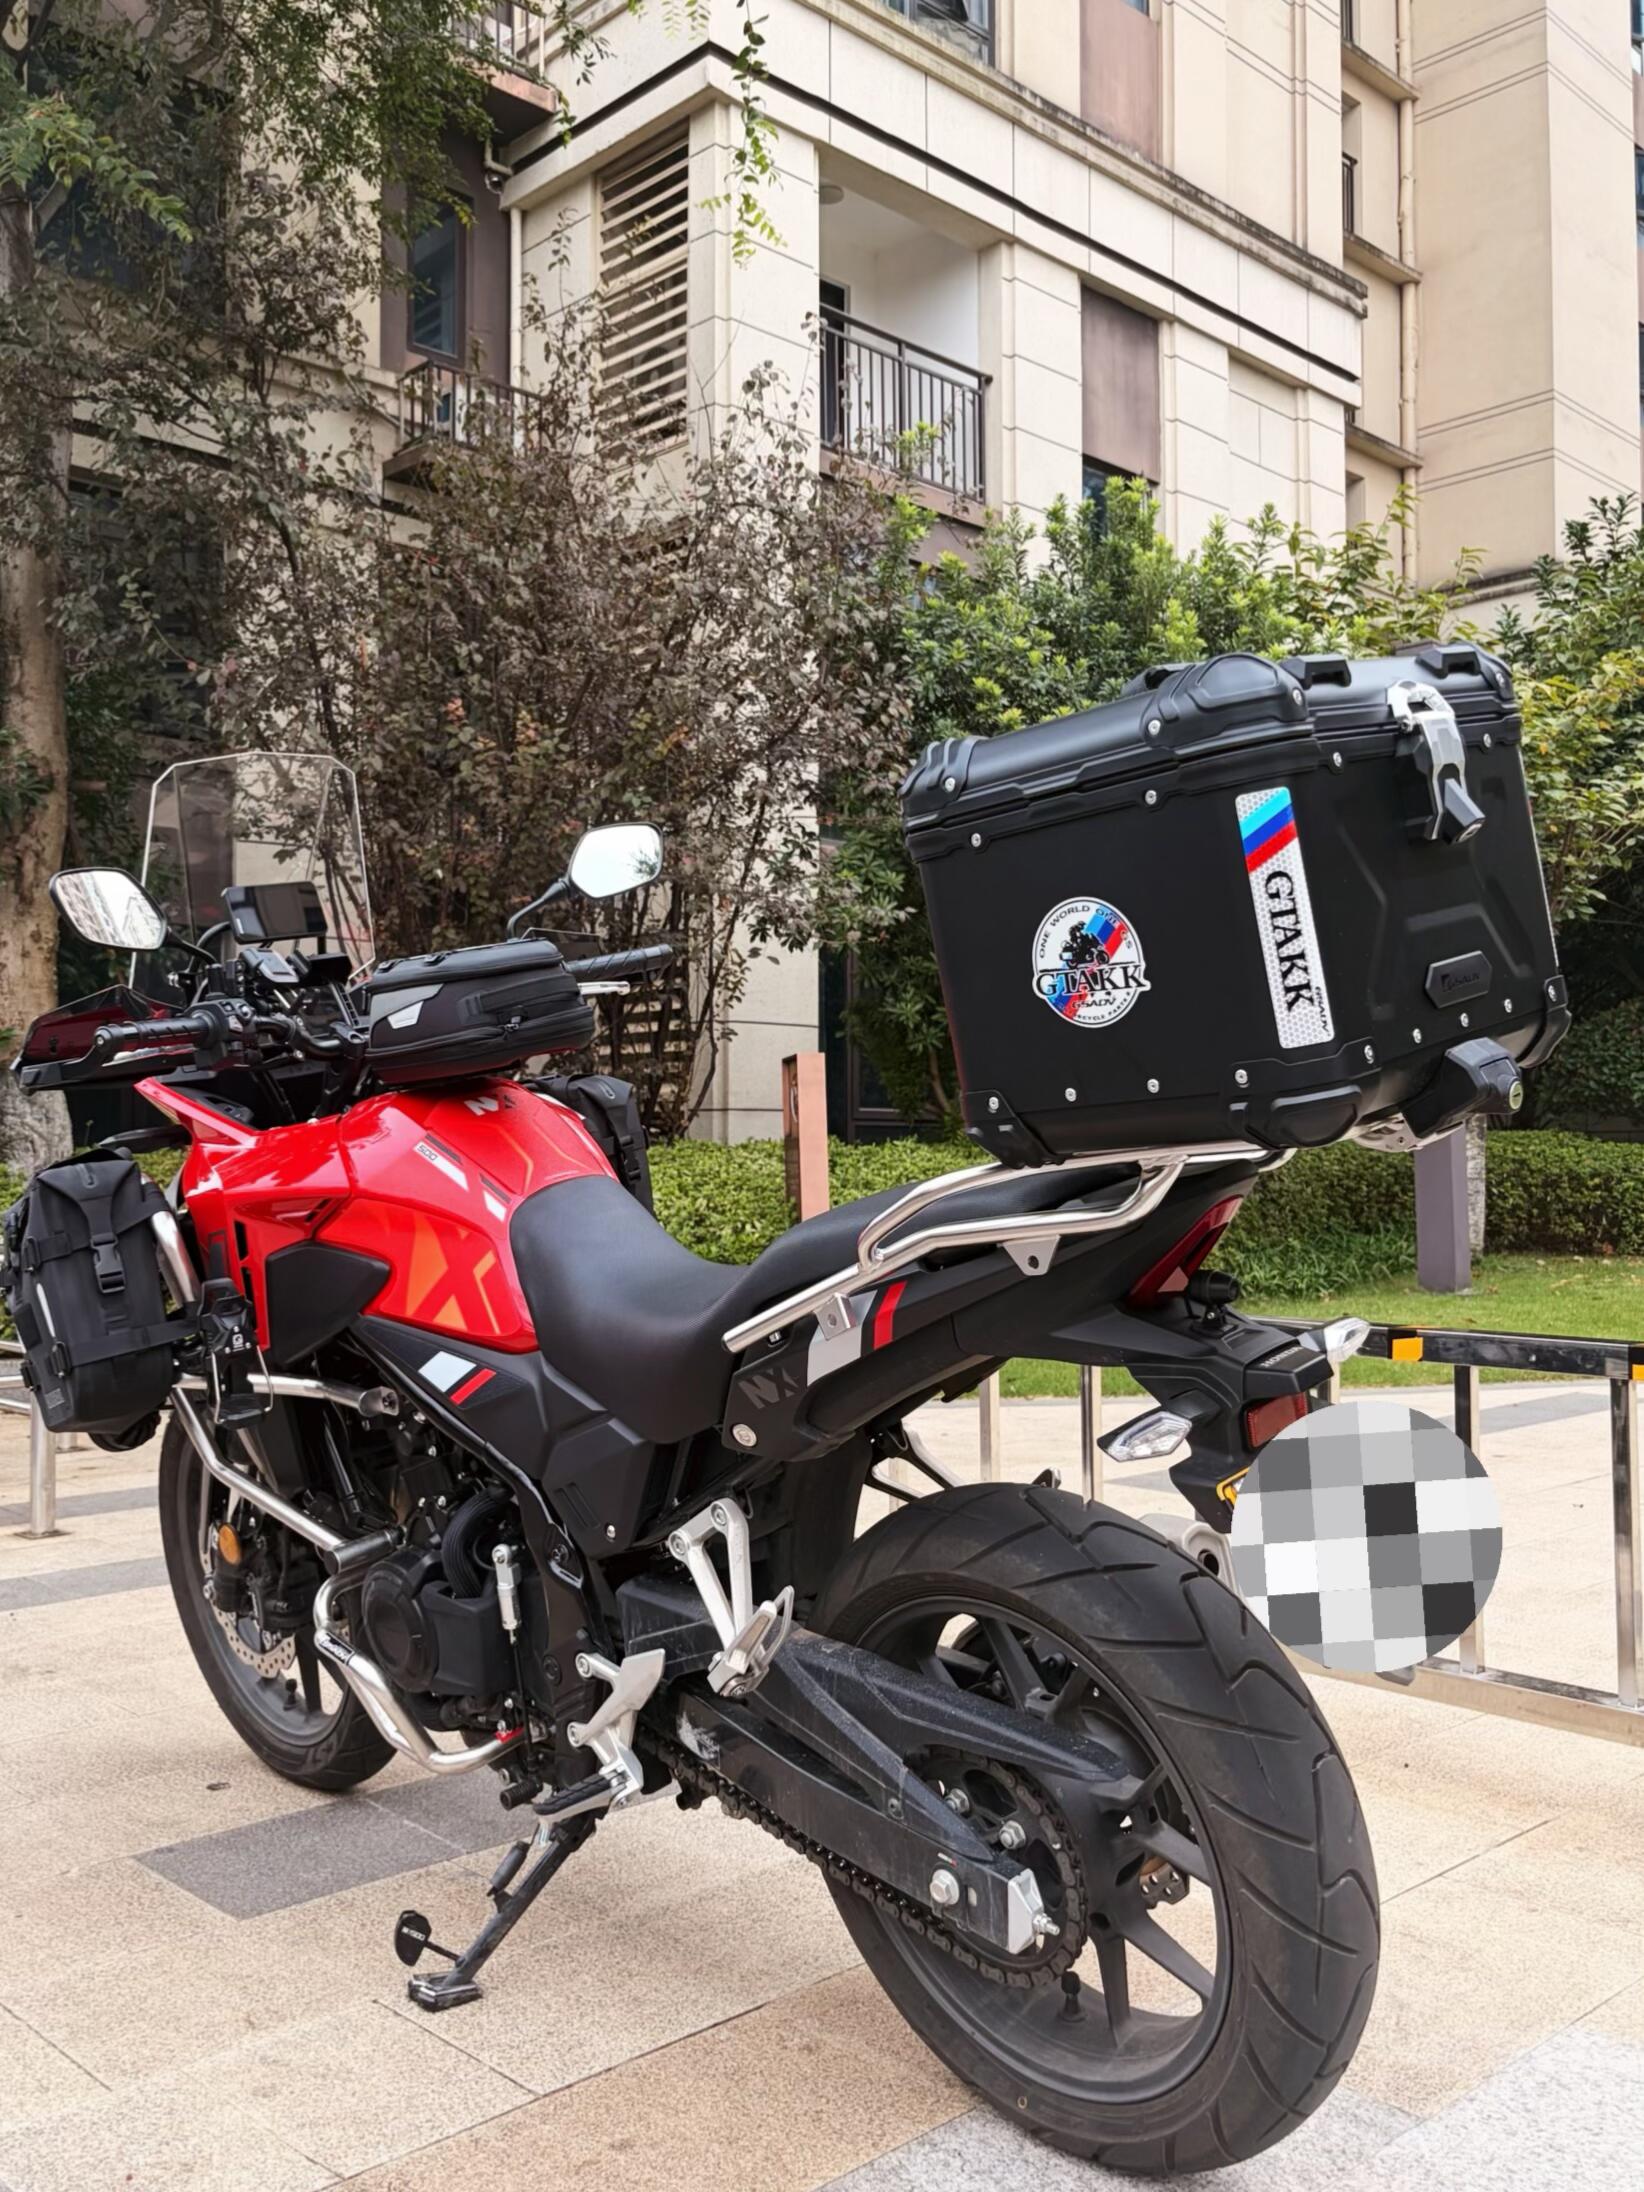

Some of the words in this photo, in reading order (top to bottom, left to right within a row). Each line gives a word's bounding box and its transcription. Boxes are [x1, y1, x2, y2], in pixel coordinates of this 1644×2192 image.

[1039, 930, 1051, 959] ONE
[1050, 905, 1091, 927] WORLD
[1265, 871, 1314, 1013] GTAKK
[1036, 964, 1147, 996] GTAKK
[418, 1144, 438, 1161] 500
